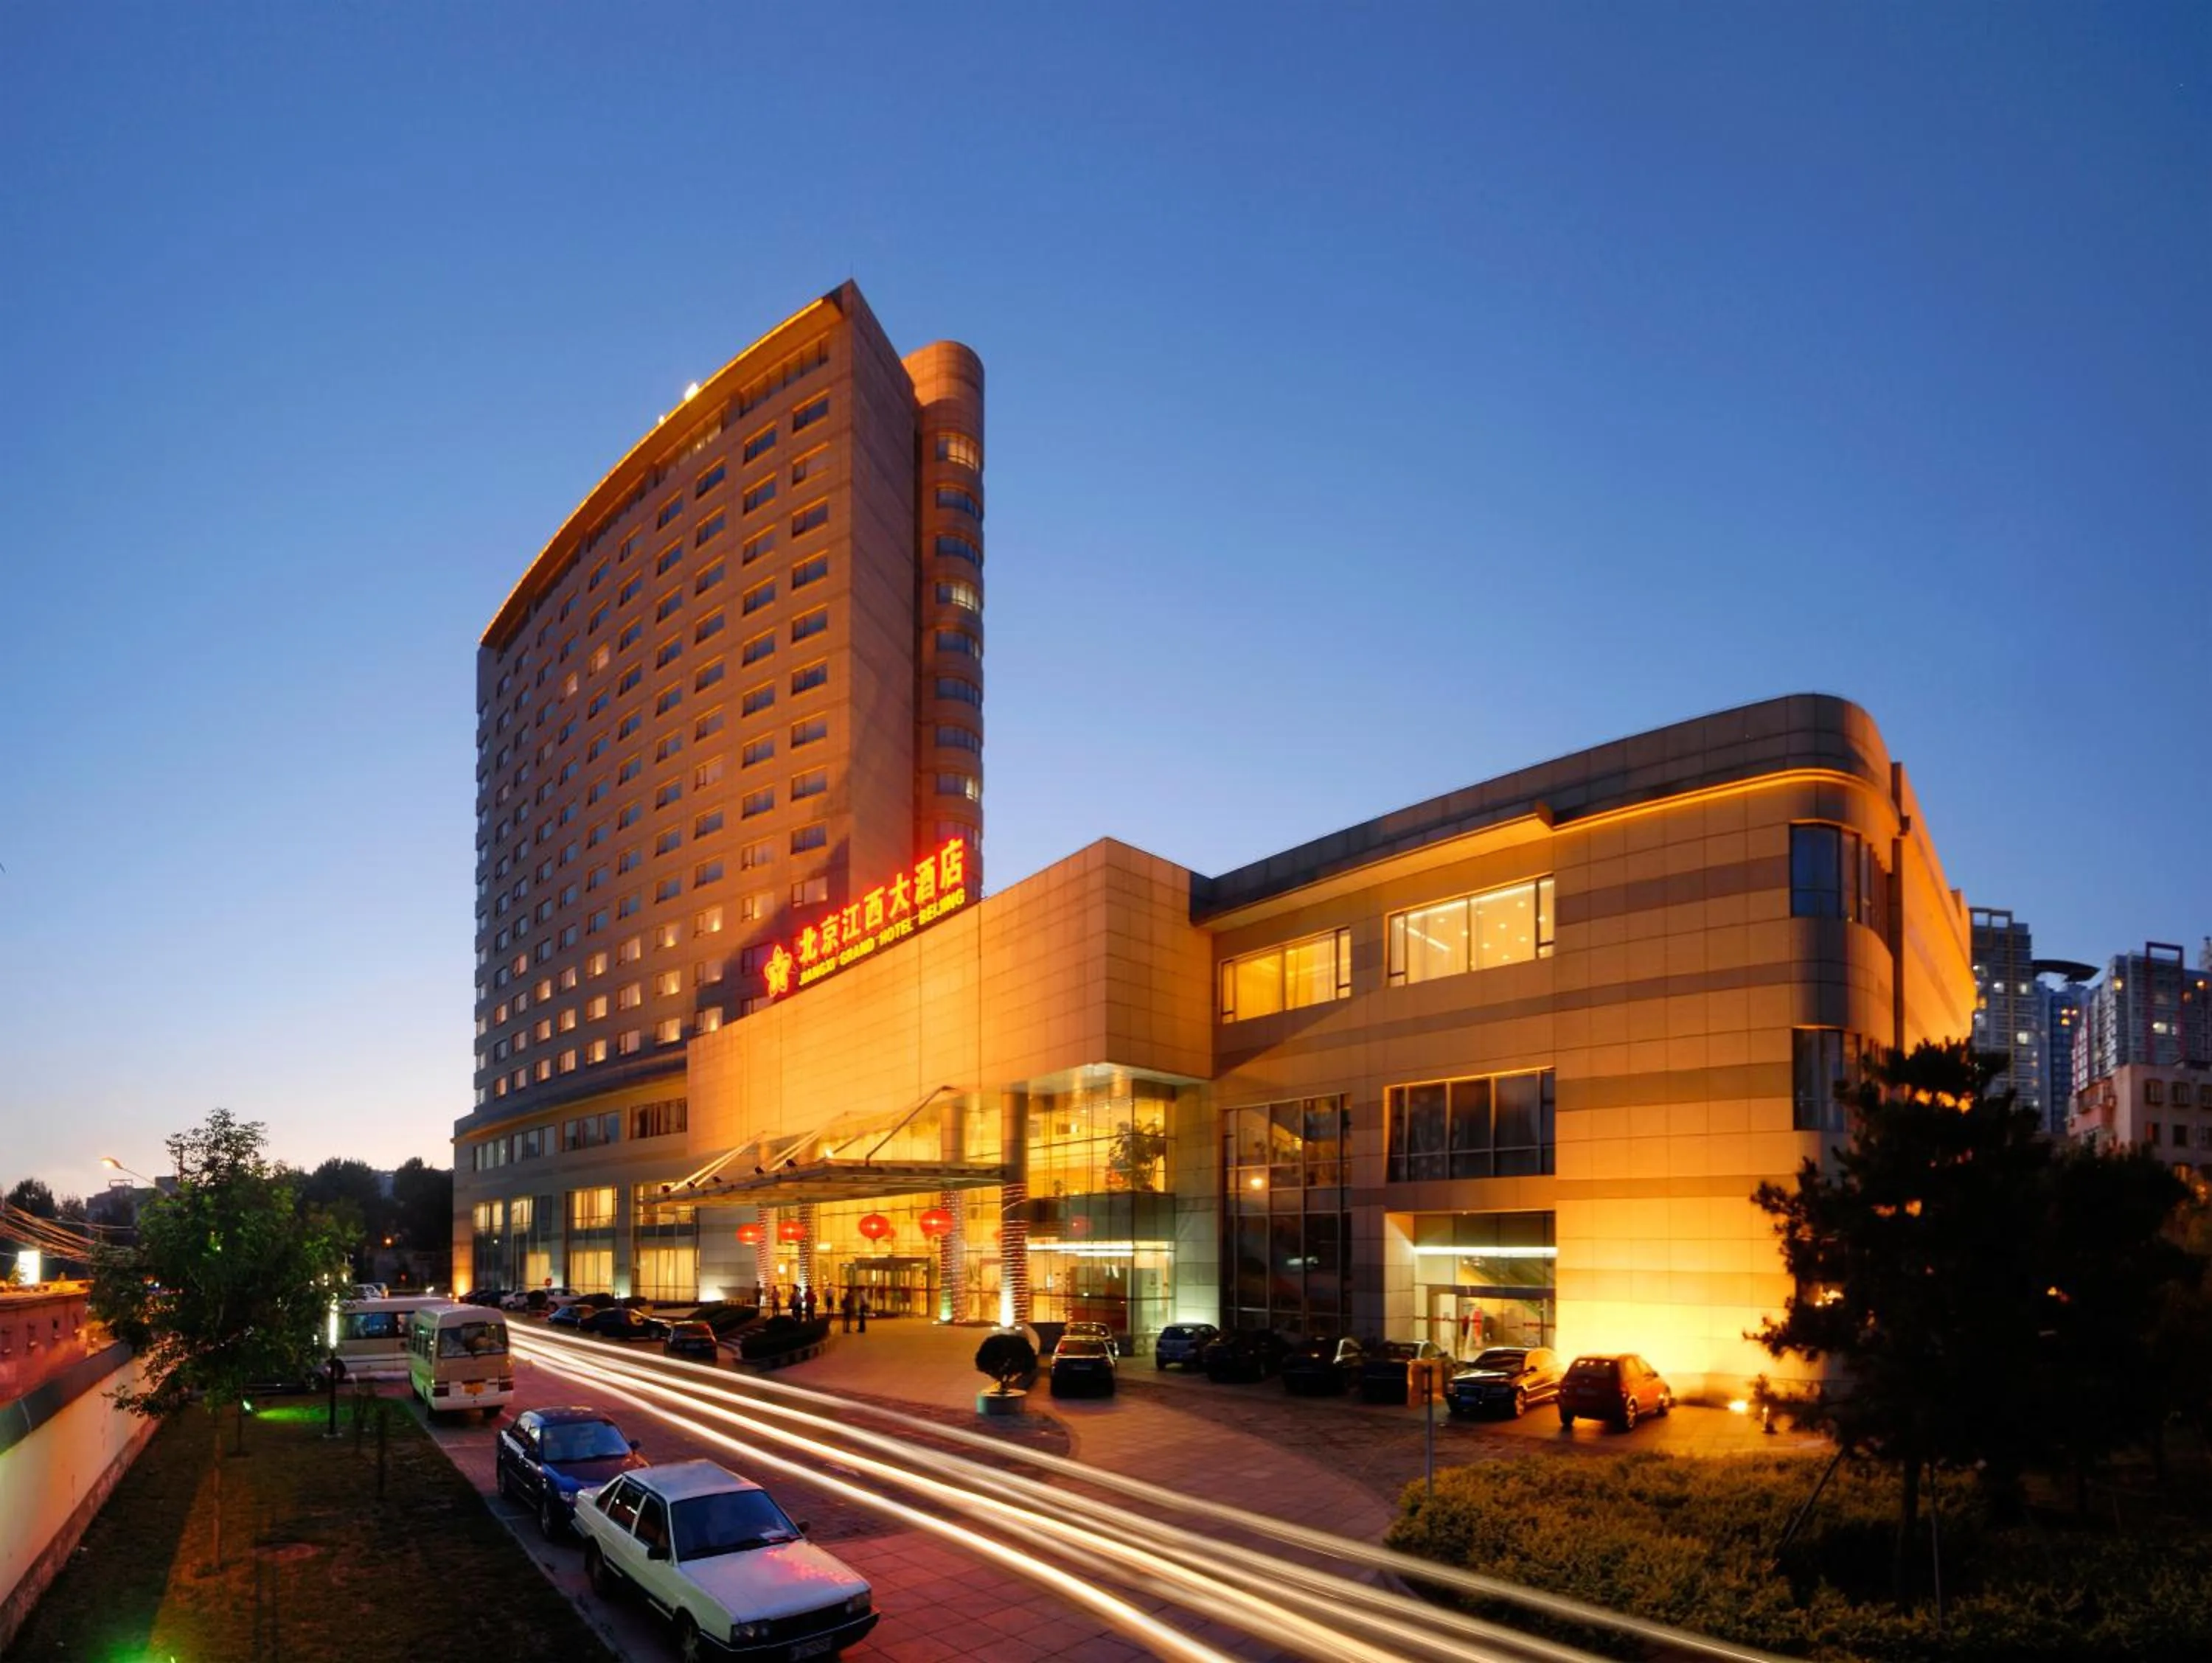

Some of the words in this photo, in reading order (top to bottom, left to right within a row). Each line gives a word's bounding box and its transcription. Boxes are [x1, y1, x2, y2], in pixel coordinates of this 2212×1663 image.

[799, 838, 964, 963] 北京江西大酒店
[840, 937, 875, 966] GRAND
[879, 917, 914, 946] HOTEL
[918, 888, 965, 926] BEIJING
